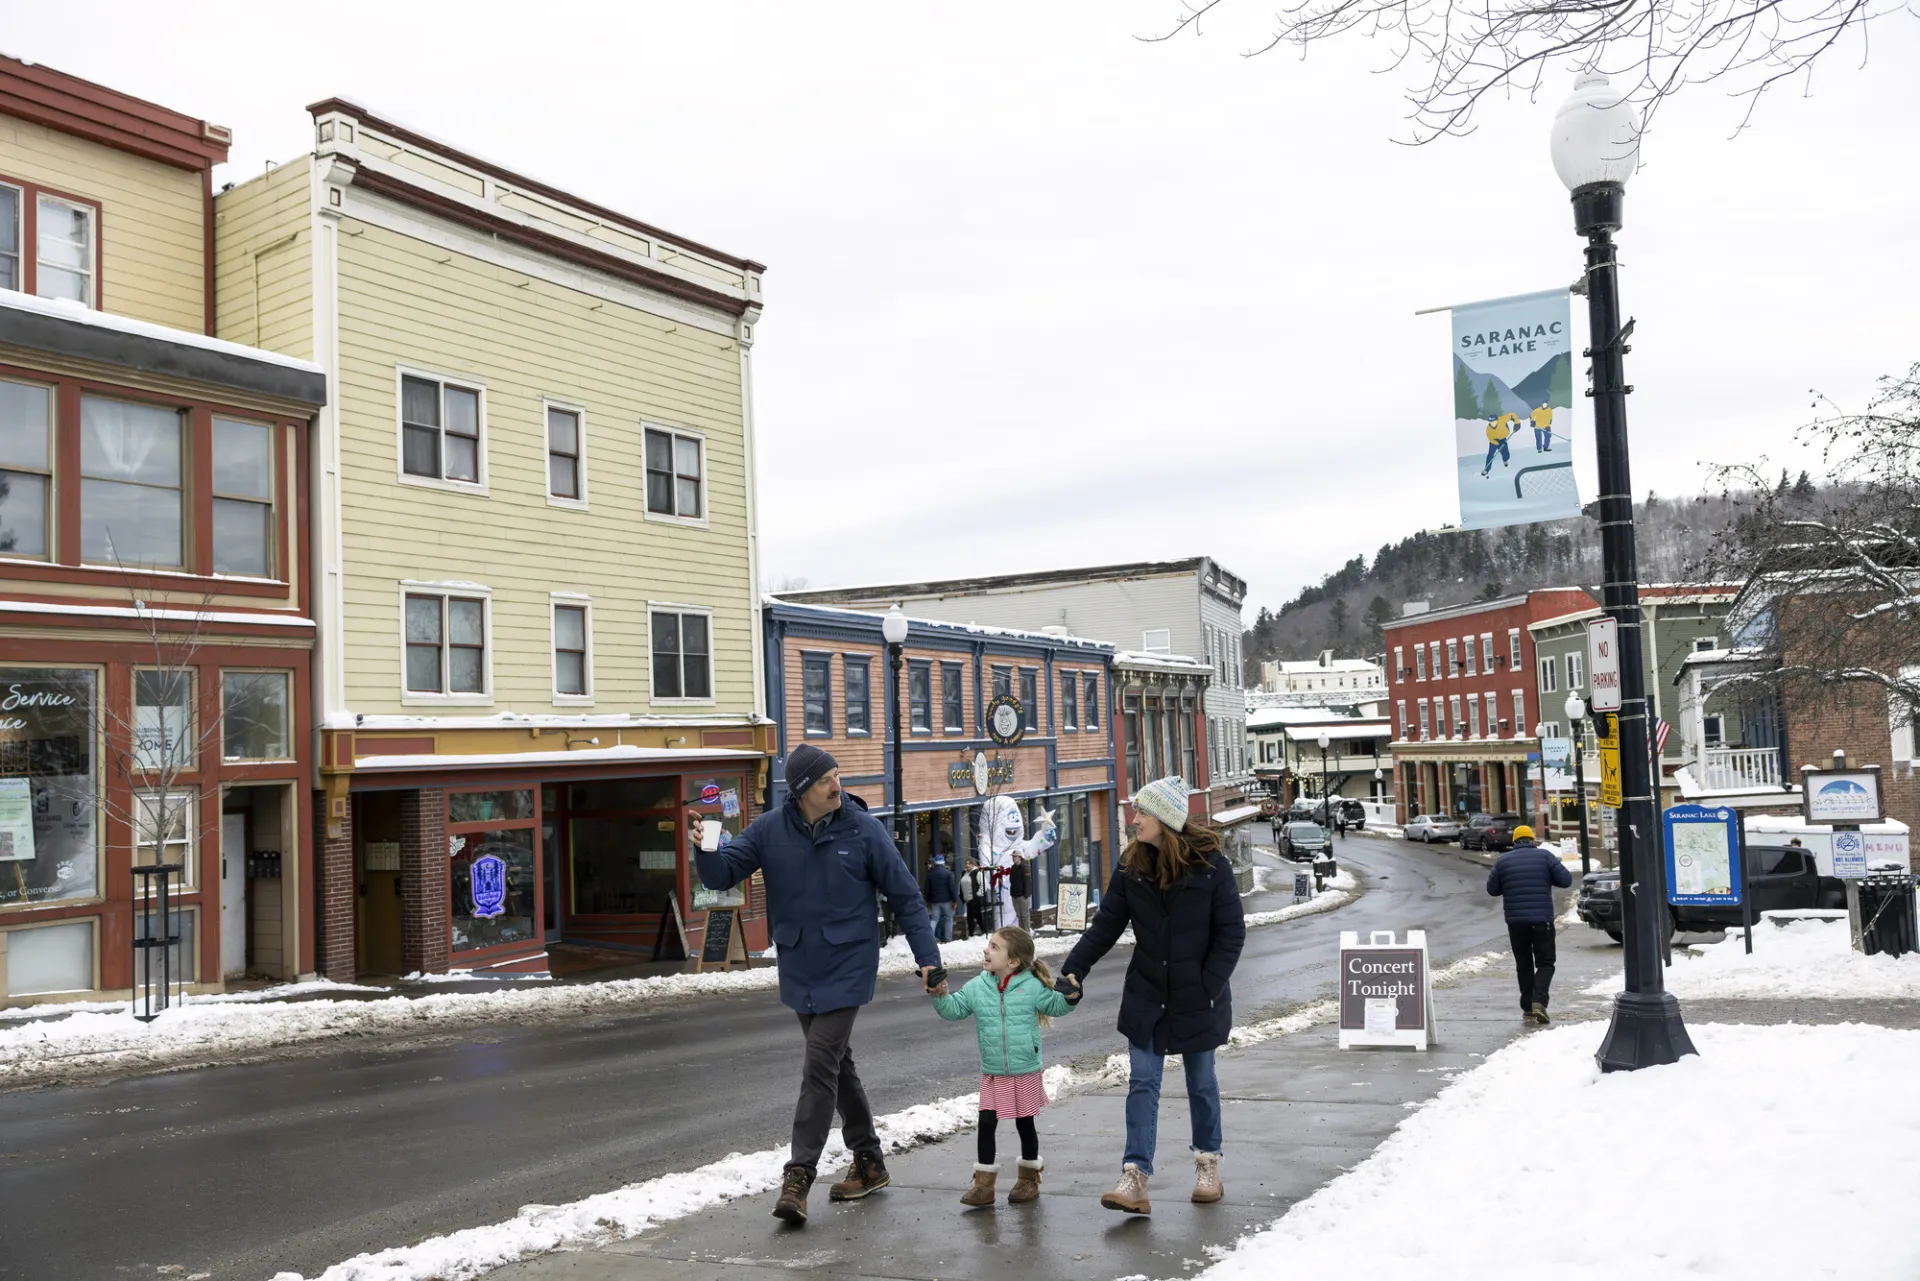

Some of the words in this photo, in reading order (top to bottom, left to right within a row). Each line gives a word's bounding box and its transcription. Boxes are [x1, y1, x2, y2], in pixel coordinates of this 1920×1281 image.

[1461, 321, 1562, 348] SARANAC
[1487, 340, 1537, 357] LAKE
[1598, 641, 1609, 658] NO
[1593, 671, 1617, 689] PARKING
[2, 684, 76, 710] Service
[1866, 842, 1904, 852] MENU
[7, 889, 17, 897] or
[694, 896, 718, 906] NATION
[1349, 958, 1415, 974] Concert
[1348, 980, 1416, 999] Tonight
